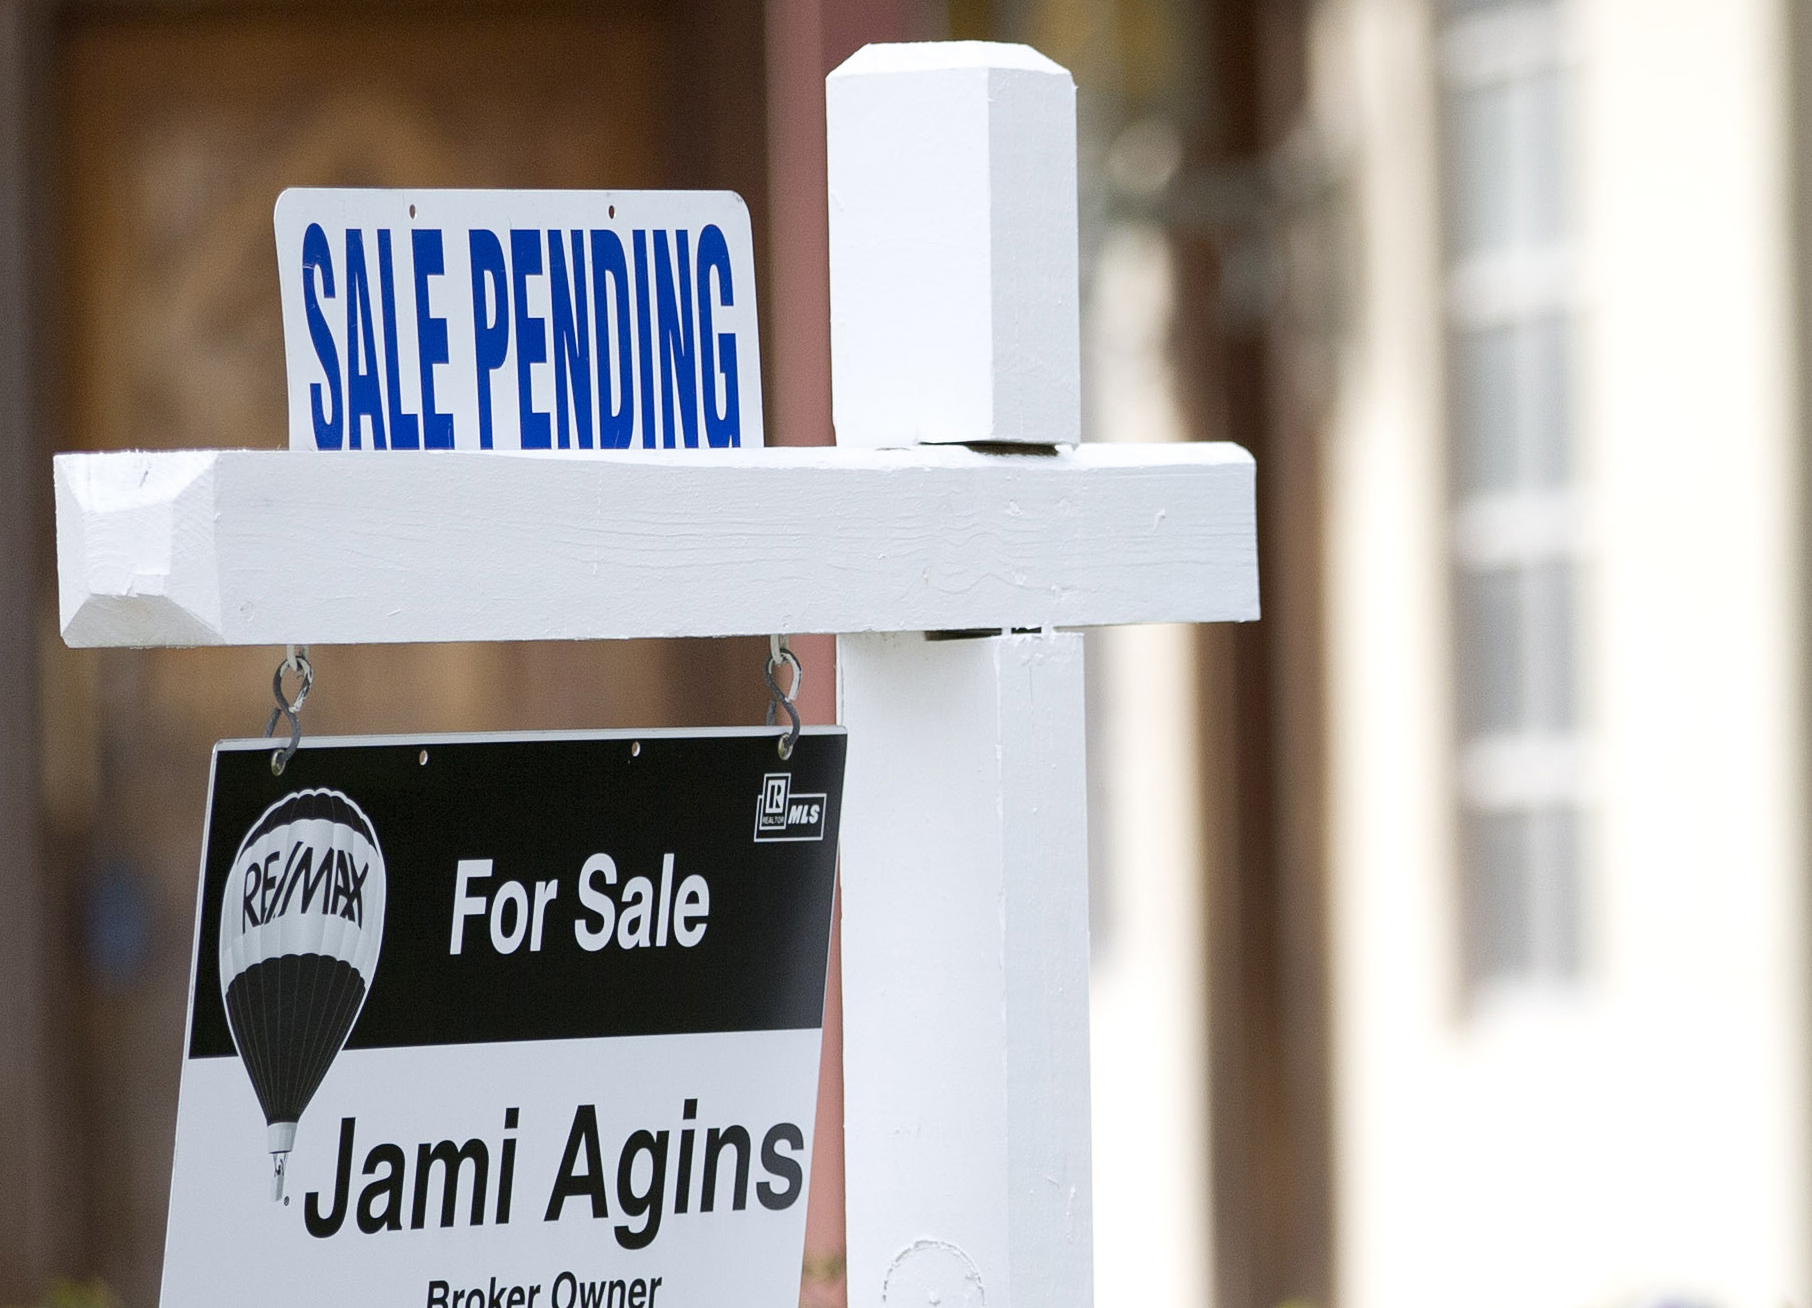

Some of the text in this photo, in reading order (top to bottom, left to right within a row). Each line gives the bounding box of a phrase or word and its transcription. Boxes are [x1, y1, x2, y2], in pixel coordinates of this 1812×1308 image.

[302, 222, 740, 450] SALE PENDING
[787, 804, 820, 824] MLS
[242, 841, 369, 934] RE/MAX
[449, 852, 710, 955] For Sale
[304, 1098, 805, 1250] Jami Agins
[427, 1271, 663, 1308] Broker Owner
